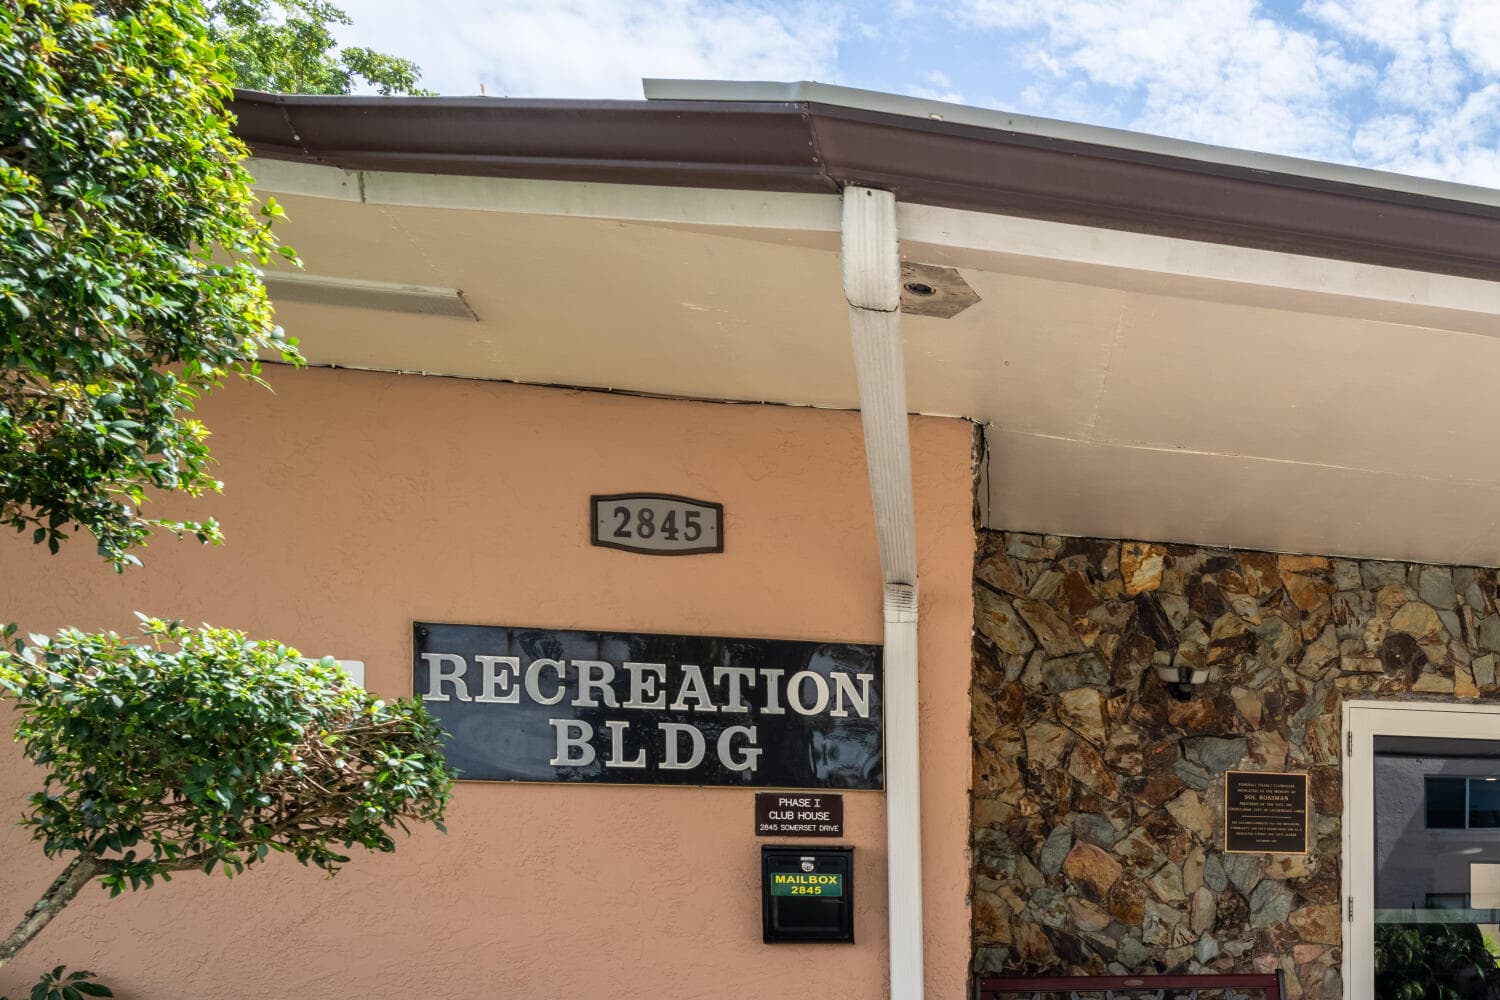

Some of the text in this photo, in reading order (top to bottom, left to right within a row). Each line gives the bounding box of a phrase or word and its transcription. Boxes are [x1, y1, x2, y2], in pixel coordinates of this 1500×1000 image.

[613, 506, 702, 541] 2845
[420, 652, 875, 718] RECREATION
[549, 718, 763, 771] BLDG
[779, 798, 821, 807] PHASE I
[769, 811, 830, 821] CLUB HOUSE
[759, 823, 840, 832] 2845 SOMERSET DRIVE
[775, 875, 837, 884] MAILBOX
[791, 886, 822, 895] 2845
